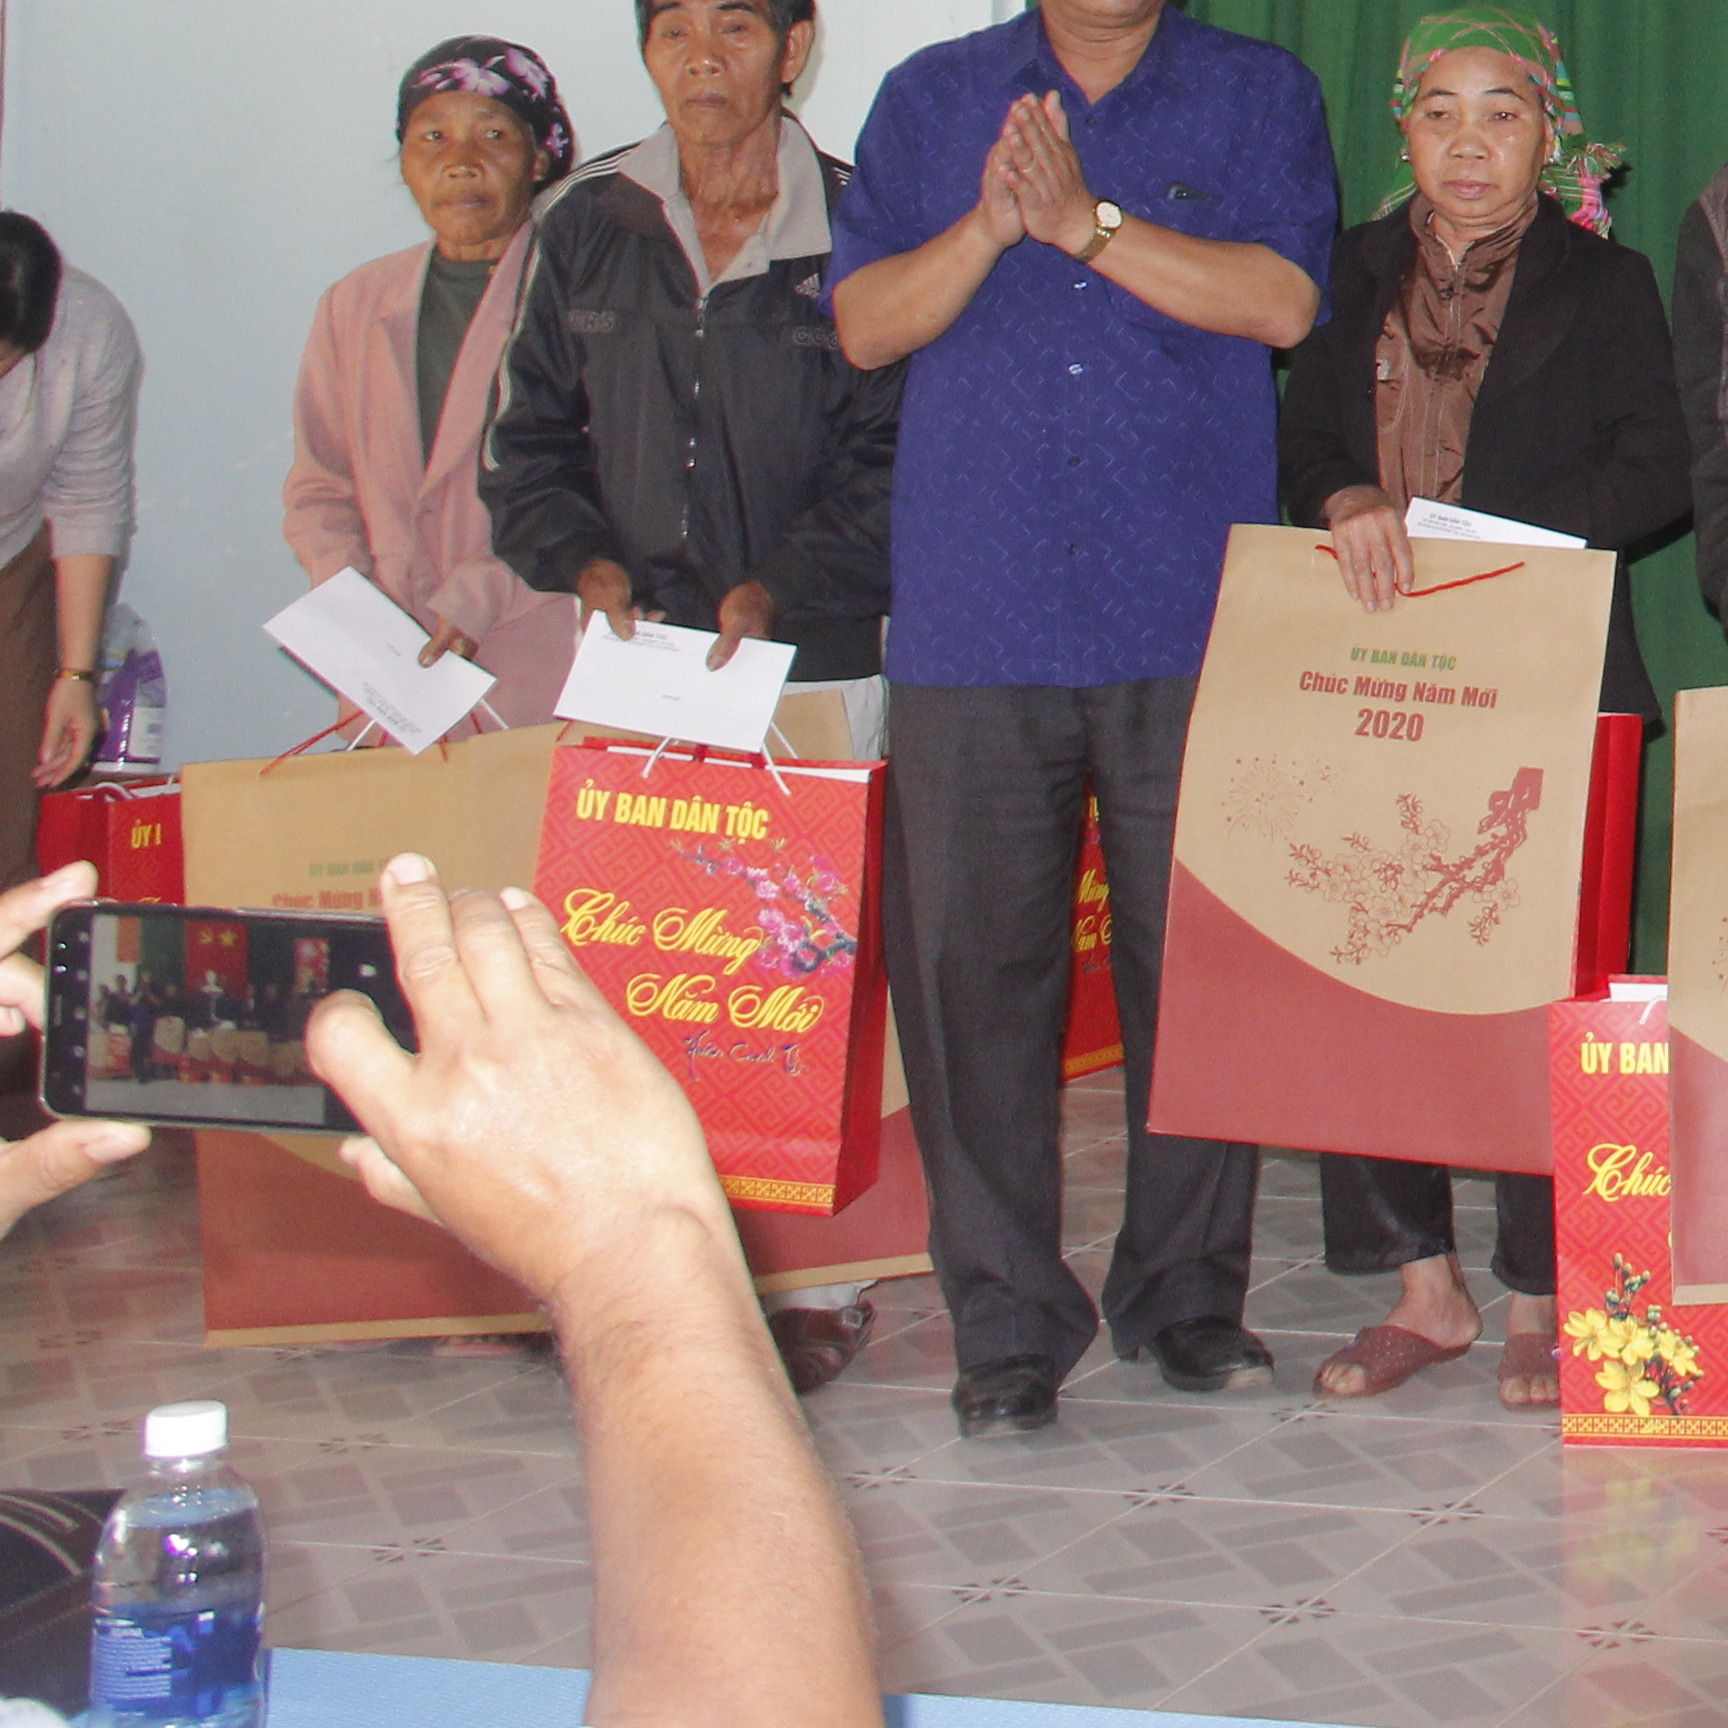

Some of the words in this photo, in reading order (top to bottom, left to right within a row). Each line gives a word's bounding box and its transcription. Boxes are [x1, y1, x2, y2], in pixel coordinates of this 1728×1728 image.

[1300, 671, 1350, 694] Chúc
[1355, 675, 1409, 702] Mừng
[1413, 683, 1457, 704] Năm
[1462, 686, 1498, 707] Mới
[1356, 708, 1425, 741] 2020
[577, 778, 611, 820] ỦY
[614, 793, 669, 828] BAN
[671, 796, 720, 834] DÂN
[726, 805, 769, 843] TỘC
[562, 888, 646, 947] Chúc
[653, 906, 765, 975] Mừng
[627, 973, 719, 1024] Năm
[728, 984, 824, 1034] Mới
[1581, 1032, 1613, 1074] ỦY
[1620, 1042, 1669, 1074] BAN
